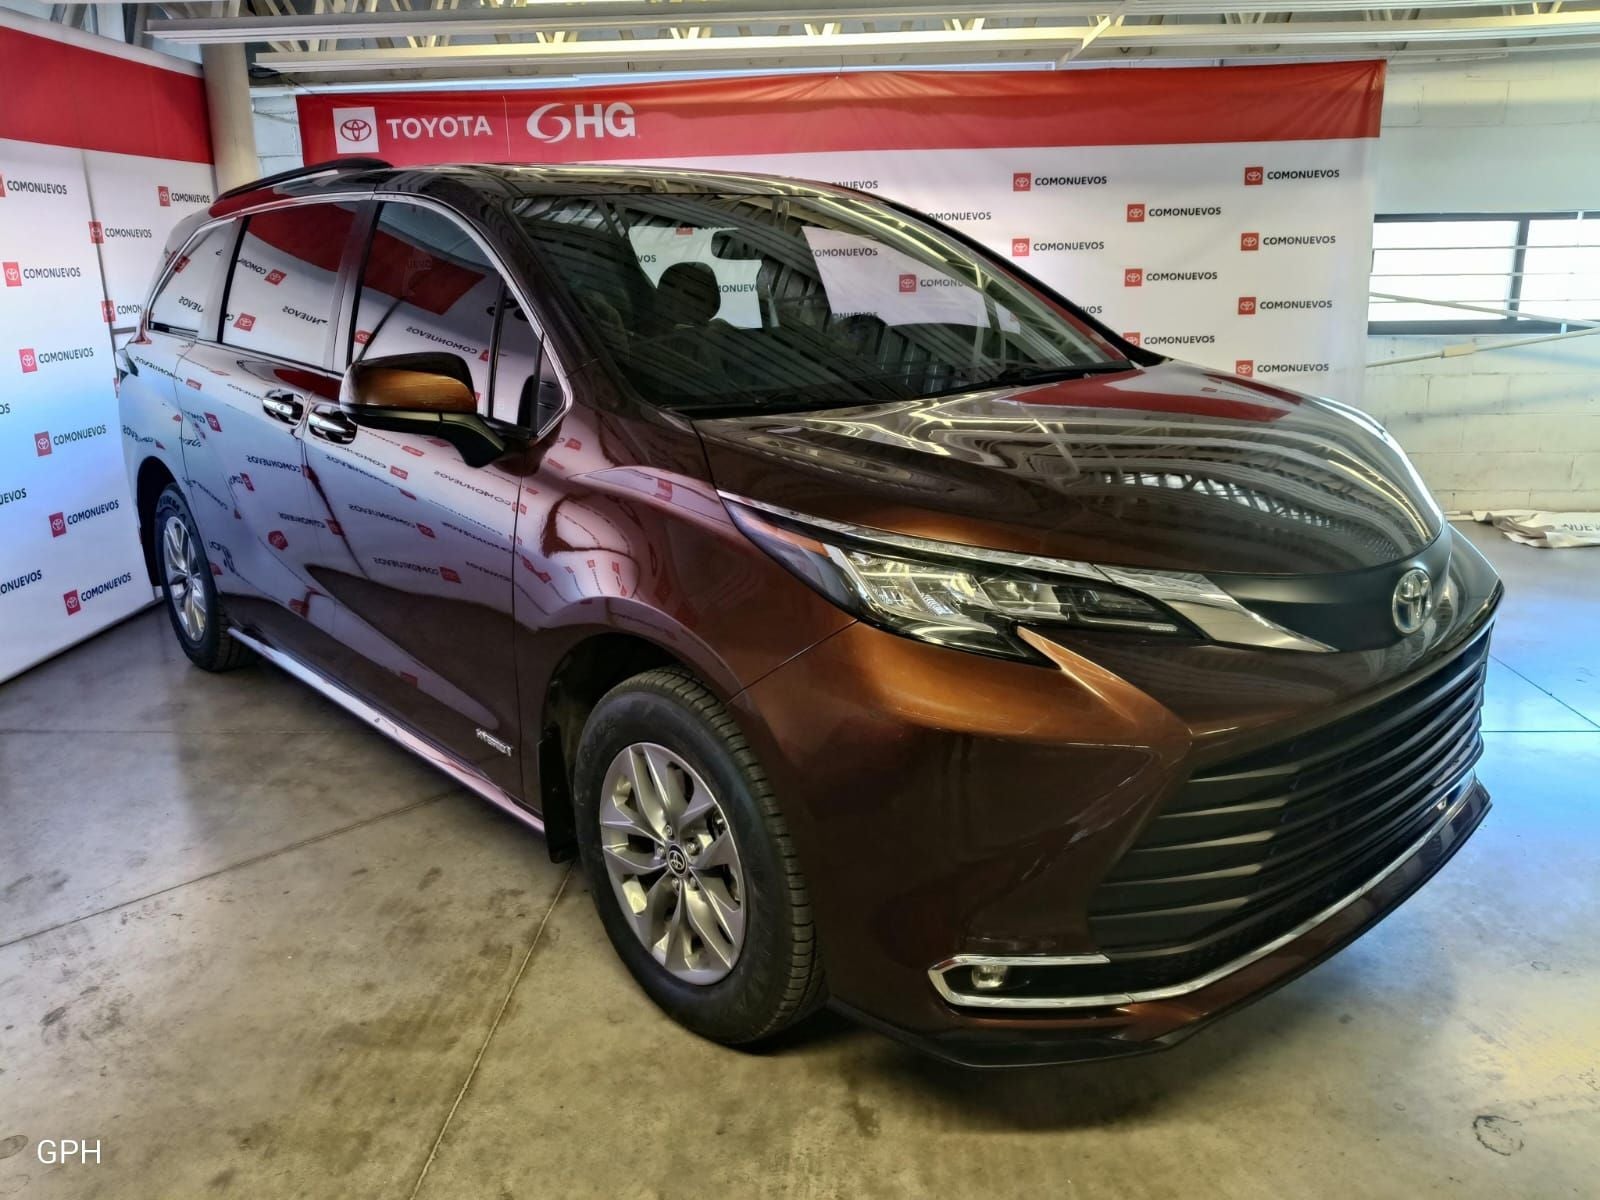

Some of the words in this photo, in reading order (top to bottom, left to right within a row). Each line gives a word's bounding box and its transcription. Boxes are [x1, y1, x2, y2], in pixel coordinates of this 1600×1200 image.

[574, 102, 636, 139] HG
[386, 115, 493, 139] TOYOTA
[1266, 169, 1340, 180] COMONUEVOS
[832, 180, 878, 190] NUEVOS
[1034, 175, 1108, 186] COMONUEVOS
[7, 180, 68, 195] COMONUEVOS
[171, 192, 210, 204] COMONUEVOS
[1148, 206, 1222, 217] COMONUEVOS
[105, 227, 152, 239] COMONUEVOS
[1033, 240, 1105, 252] COMONUEVOS
[1262, 235, 1336, 246] COMONUEVOS
[813, 247, 878, 257] OMONUEVOS
[23, 267, 81, 280] COMONUEVOS
[1145, 271, 1218, 282] COMONUEVOS
[718, 283, 757, 293] ONUEV
[1259, 299, 1333, 310] COMONUEVOS
[1143, 335, 1216, 345] COMONUEVOS
[39, 347, 94, 364] COMONUEVOS
[1256, 363, 1329, 373] COMONUEVOS
[53, 424, 107, 446] COMONUEVOS
[67, 499, 120, 526] COMONUEVOS
[81, 571, 132, 602] COMONUEVOS
